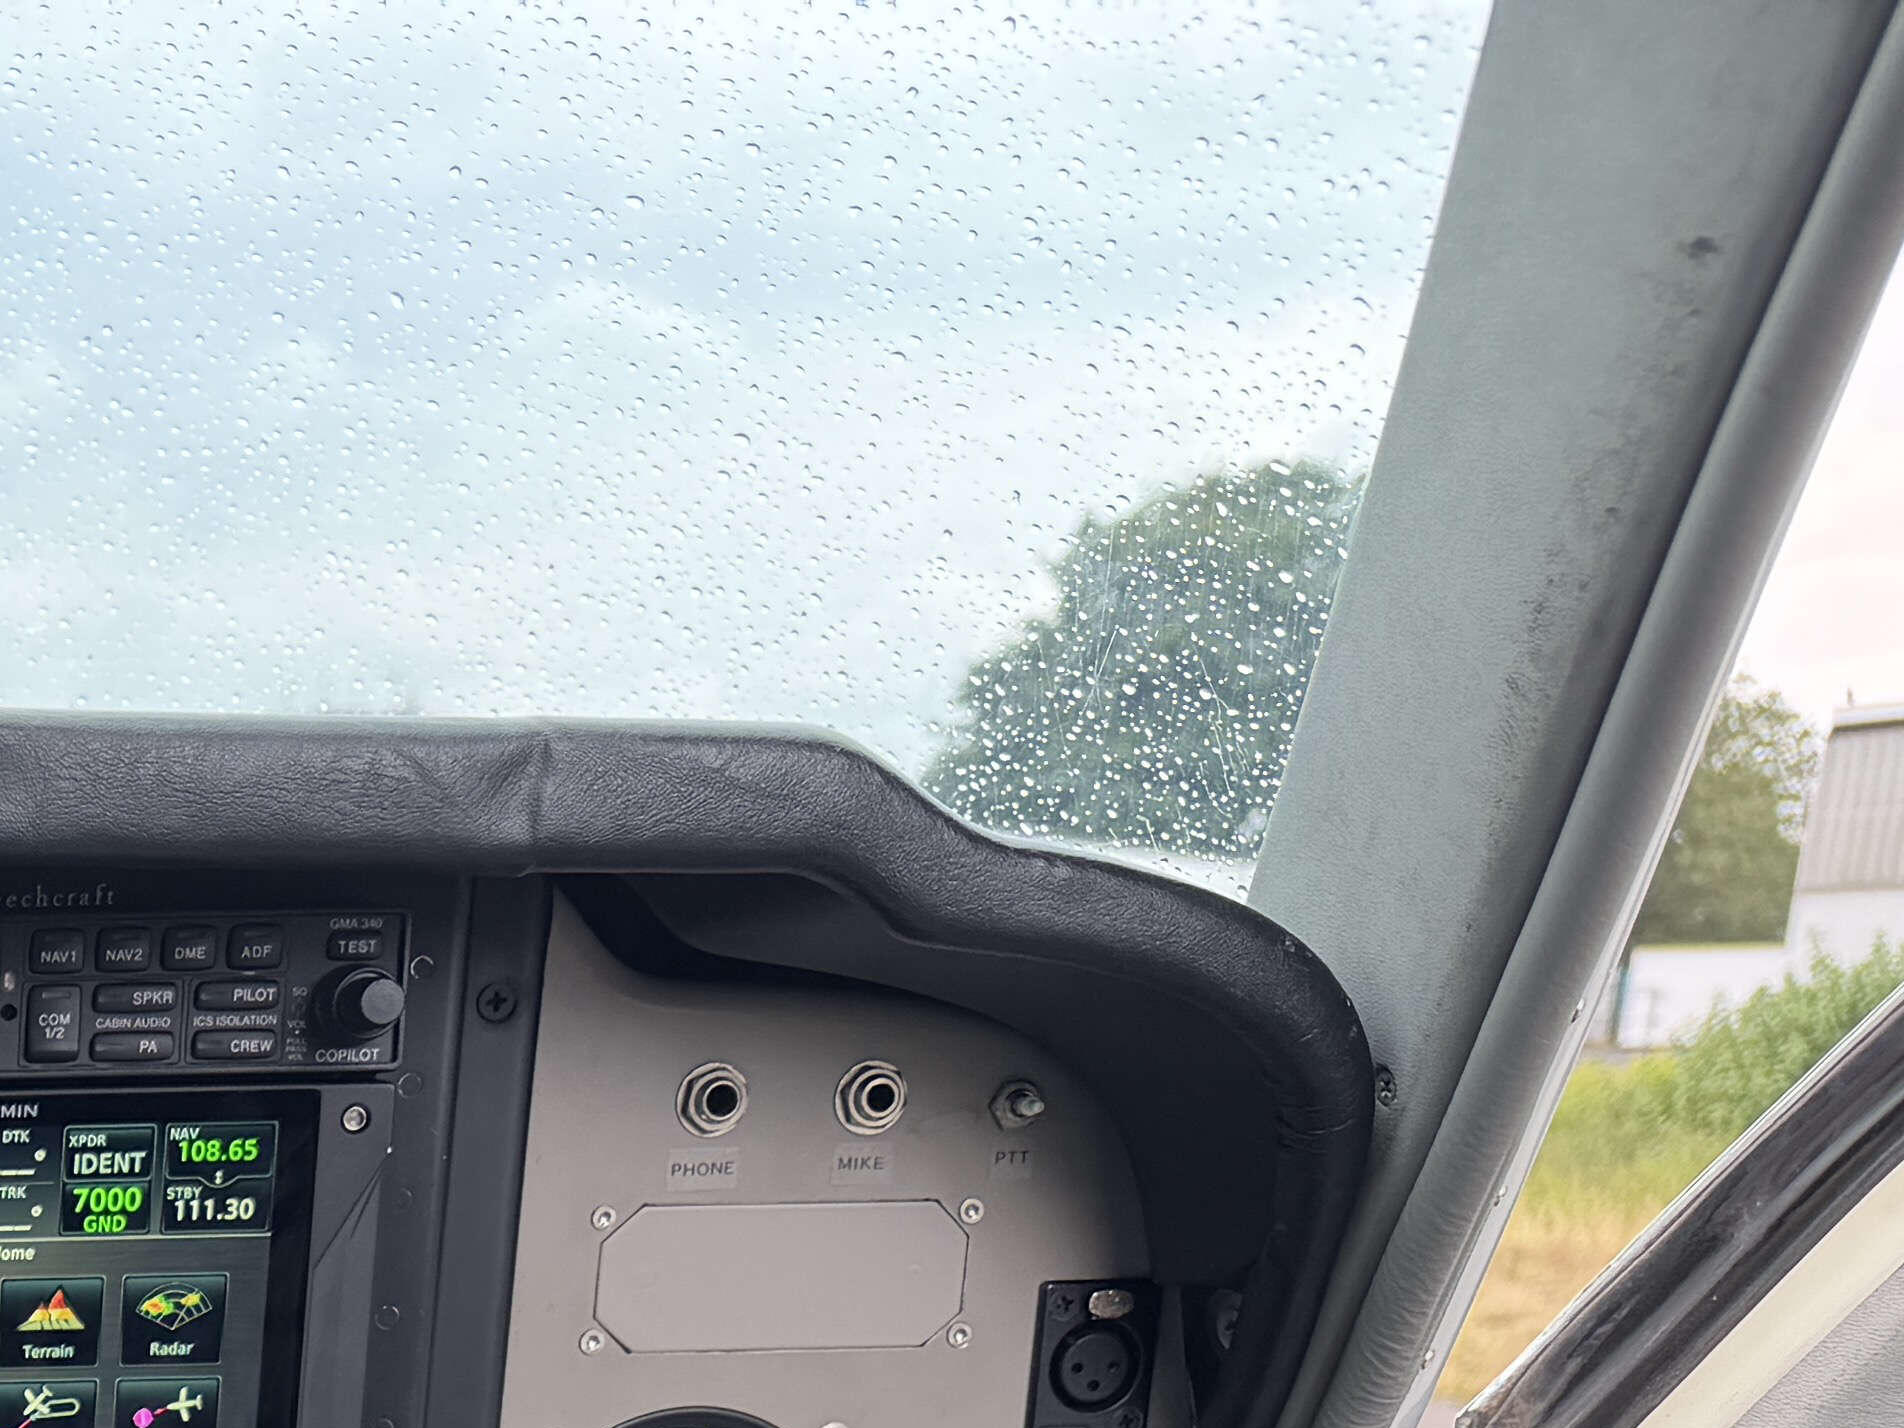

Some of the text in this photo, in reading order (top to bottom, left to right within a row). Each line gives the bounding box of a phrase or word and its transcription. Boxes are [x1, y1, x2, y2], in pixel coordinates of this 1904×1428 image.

[315, 1048, 379, 1064] COPILOT
[176, 1137, 259, 1165] 108.65
[71, 1151, 145, 1177] IDENT
[670, 1161, 734, 1177] PHONE
[838, 1155, 885, 1171] MIKE
[72, 1186, 142, 1214] 7000
[171, 1196, 255, 1222] 111.30
[83, 1215, 127, 1233] GND
[22, 1342, 74, 1360] Terrain
[148, 1339, 195, 1357] Radar
